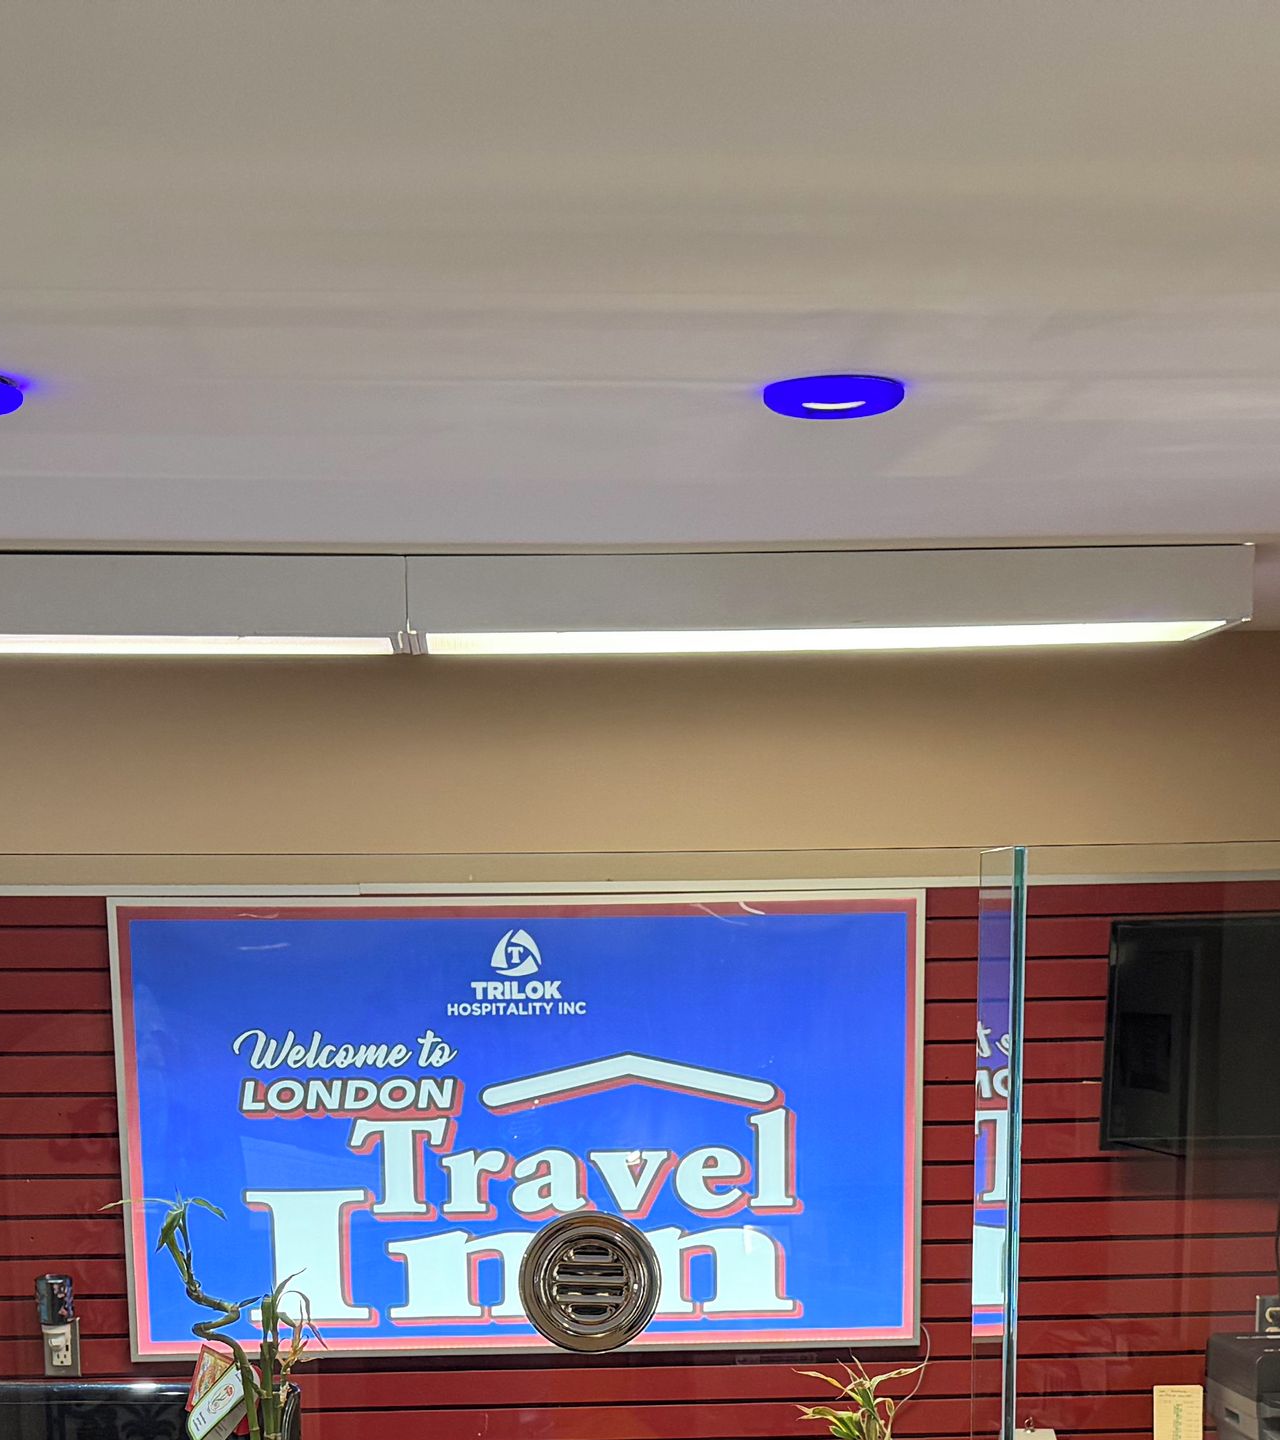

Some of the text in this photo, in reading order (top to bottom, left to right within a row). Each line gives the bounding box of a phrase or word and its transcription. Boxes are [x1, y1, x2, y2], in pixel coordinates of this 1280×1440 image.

[446, 1001, 587, 1016] HOSPITALITY INC
[471, 981, 562, 1000] TRILOK
[233, 1029, 458, 1070] Welcome to
[240, 1079, 455, 1112] LONDON
[351, 1109, 796, 1216] Travel
[244, 1189, 796, 1321] Inn
